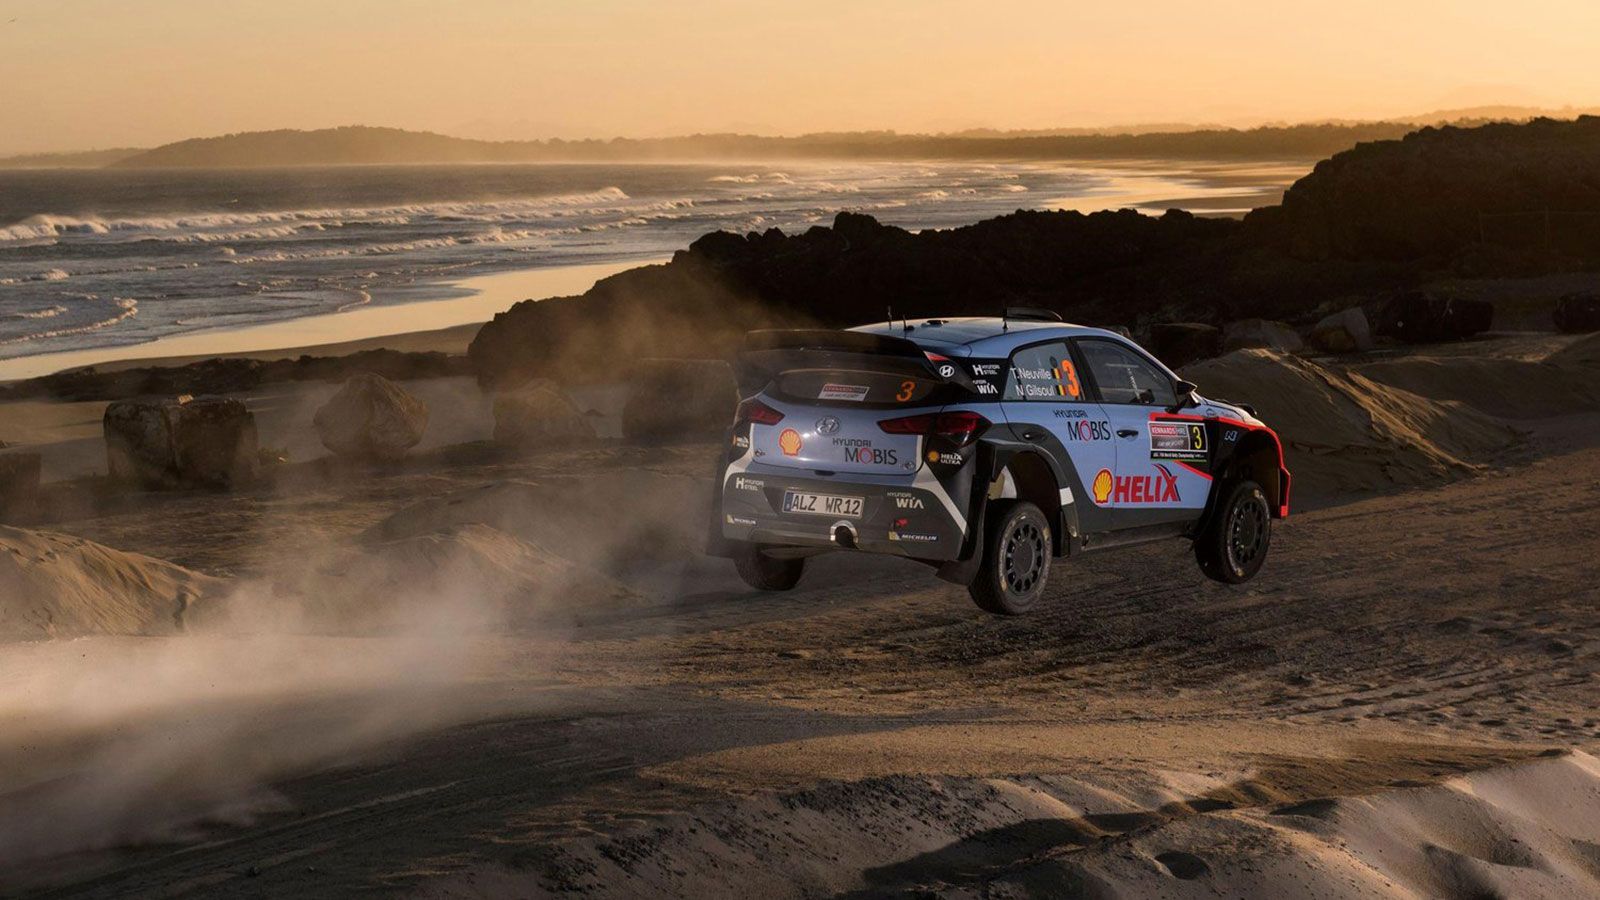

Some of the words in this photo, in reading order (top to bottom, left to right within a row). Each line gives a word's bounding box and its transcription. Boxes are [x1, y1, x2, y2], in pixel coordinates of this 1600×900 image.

[1061, 359, 1080, 397] 3
[896, 381, 916, 402] 3
[1053, 409, 1088, 418] HYUNDAI
[1067, 420, 1111, 443] MOBIS
[1192, 425, 1202, 450] 3
[832, 438, 872, 447] HYUNDAI
[844, 447, 898, 465] MOBIS
[940, 453, 962, 461] HELIX
[1113, 463, 1181, 503] HELIX
[792, 495, 818, 511] ALZ
[825, 497, 861, 515] WR12
[901, 533, 938, 541] MICHELIN
